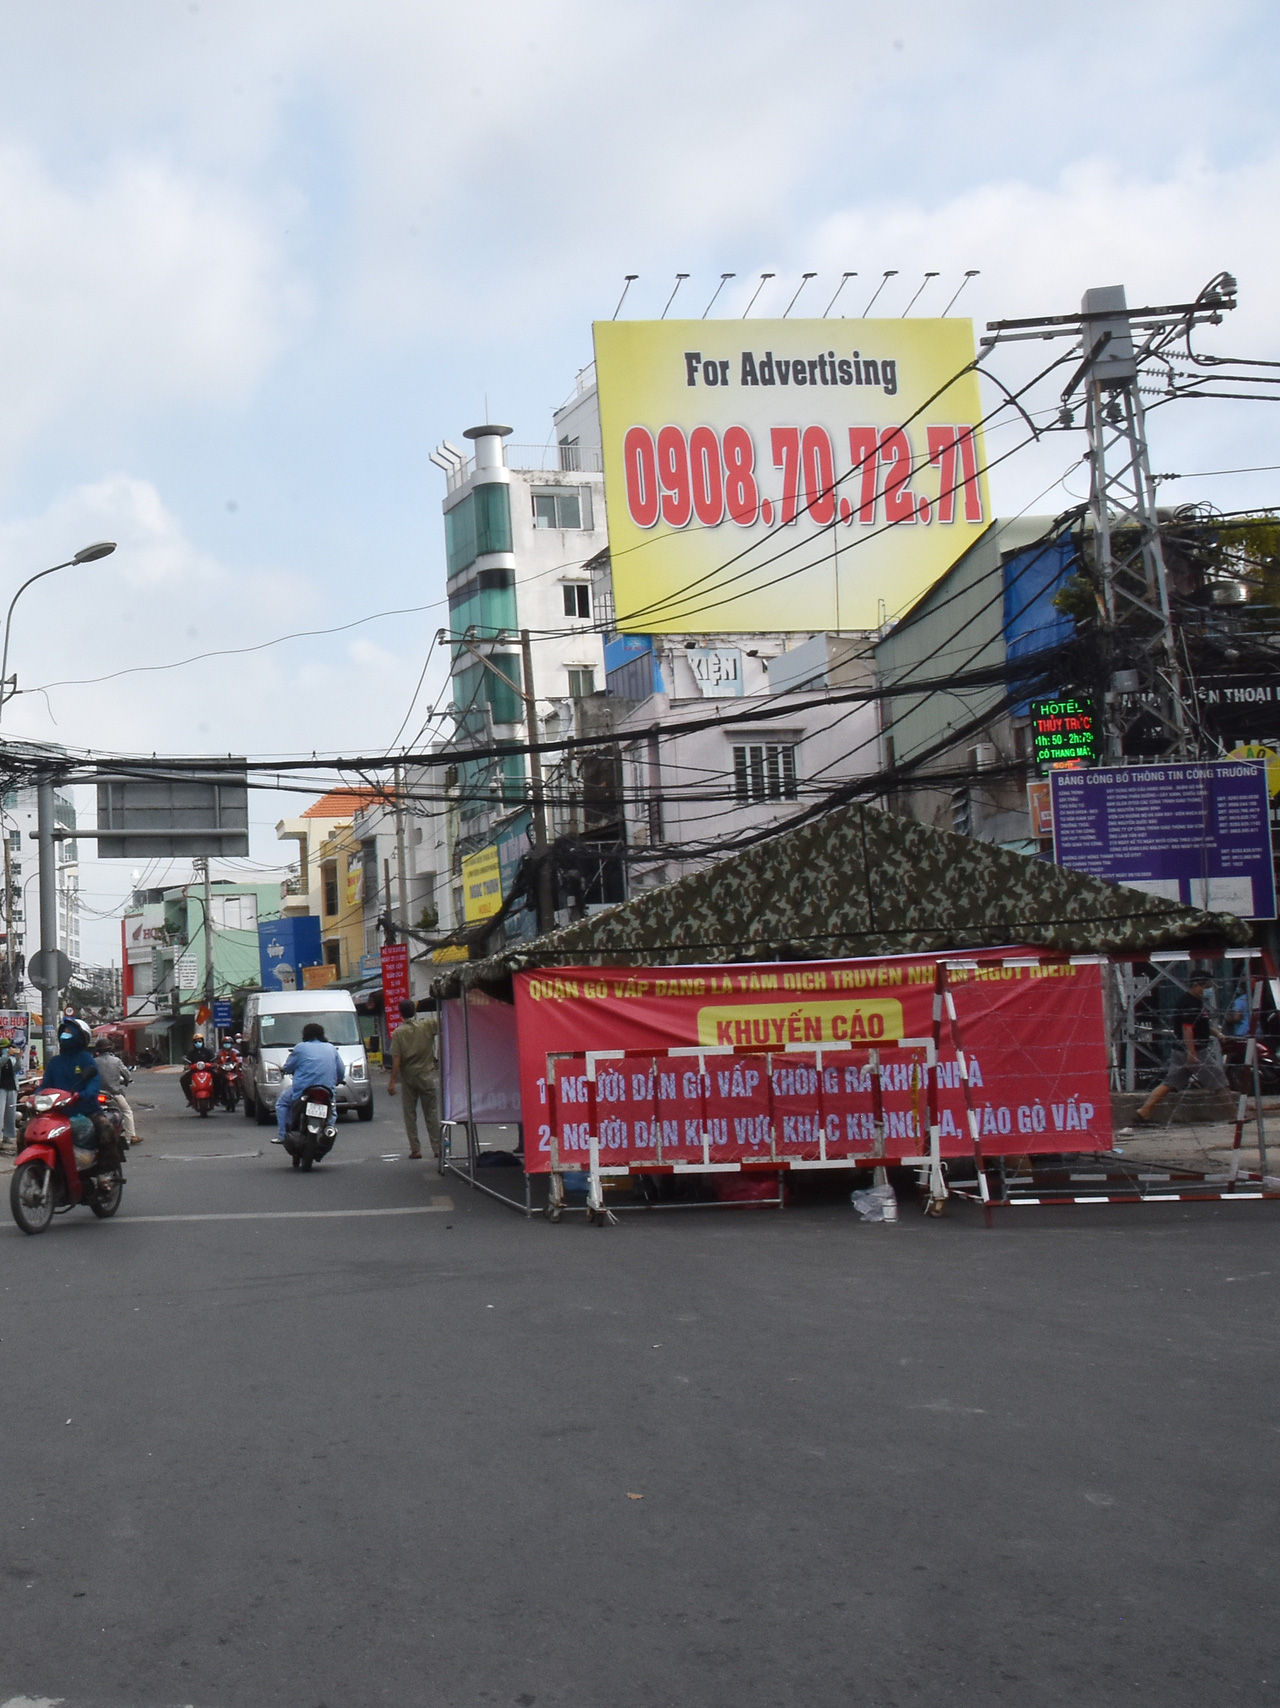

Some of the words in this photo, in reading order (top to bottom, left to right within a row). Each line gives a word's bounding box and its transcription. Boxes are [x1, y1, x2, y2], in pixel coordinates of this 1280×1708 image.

[683, 350, 730, 388] For
[740, 350, 898, 396] Advertising
[623, 424, 985, 529] 0908.70.72.71
[1040, 702, 1083, 715] HOTEL
[1224, 686, 1271, 704] THOẠI
[1050, 748, 1076, 758] THANG
[1058, 773, 1084, 786] BẢNG
[1086, 772, 1113, 785] CÔNG
[1131, 769, 1165, 782] THÔNG
[1167, 770, 1183, 780] TIN
[1186, 768, 1214, 779] CÔNG
[529, 978, 578, 1003] QUẬN
[583, 976, 608, 999] GÒ
[613, 974, 649, 998] VẤP
[655, 977, 706, 997] ĐANG
[710, 974, 733, 994] LÀ
[737, 971, 778, 992] TÂM
[784, 971, 827, 995] DỊCH
[830, 962, 903, 990] TRUYỀN
[716, 1008, 823, 1046] KHUYẾN
[832, 1009, 885, 1041] CÁO
[717, 1061, 760, 1097] VẤP
[733, 1113, 772, 1150] VỰC
[1017, 1097, 1047, 1132] GÒ
[1050, 1093, 1095, 1131] VẤP
